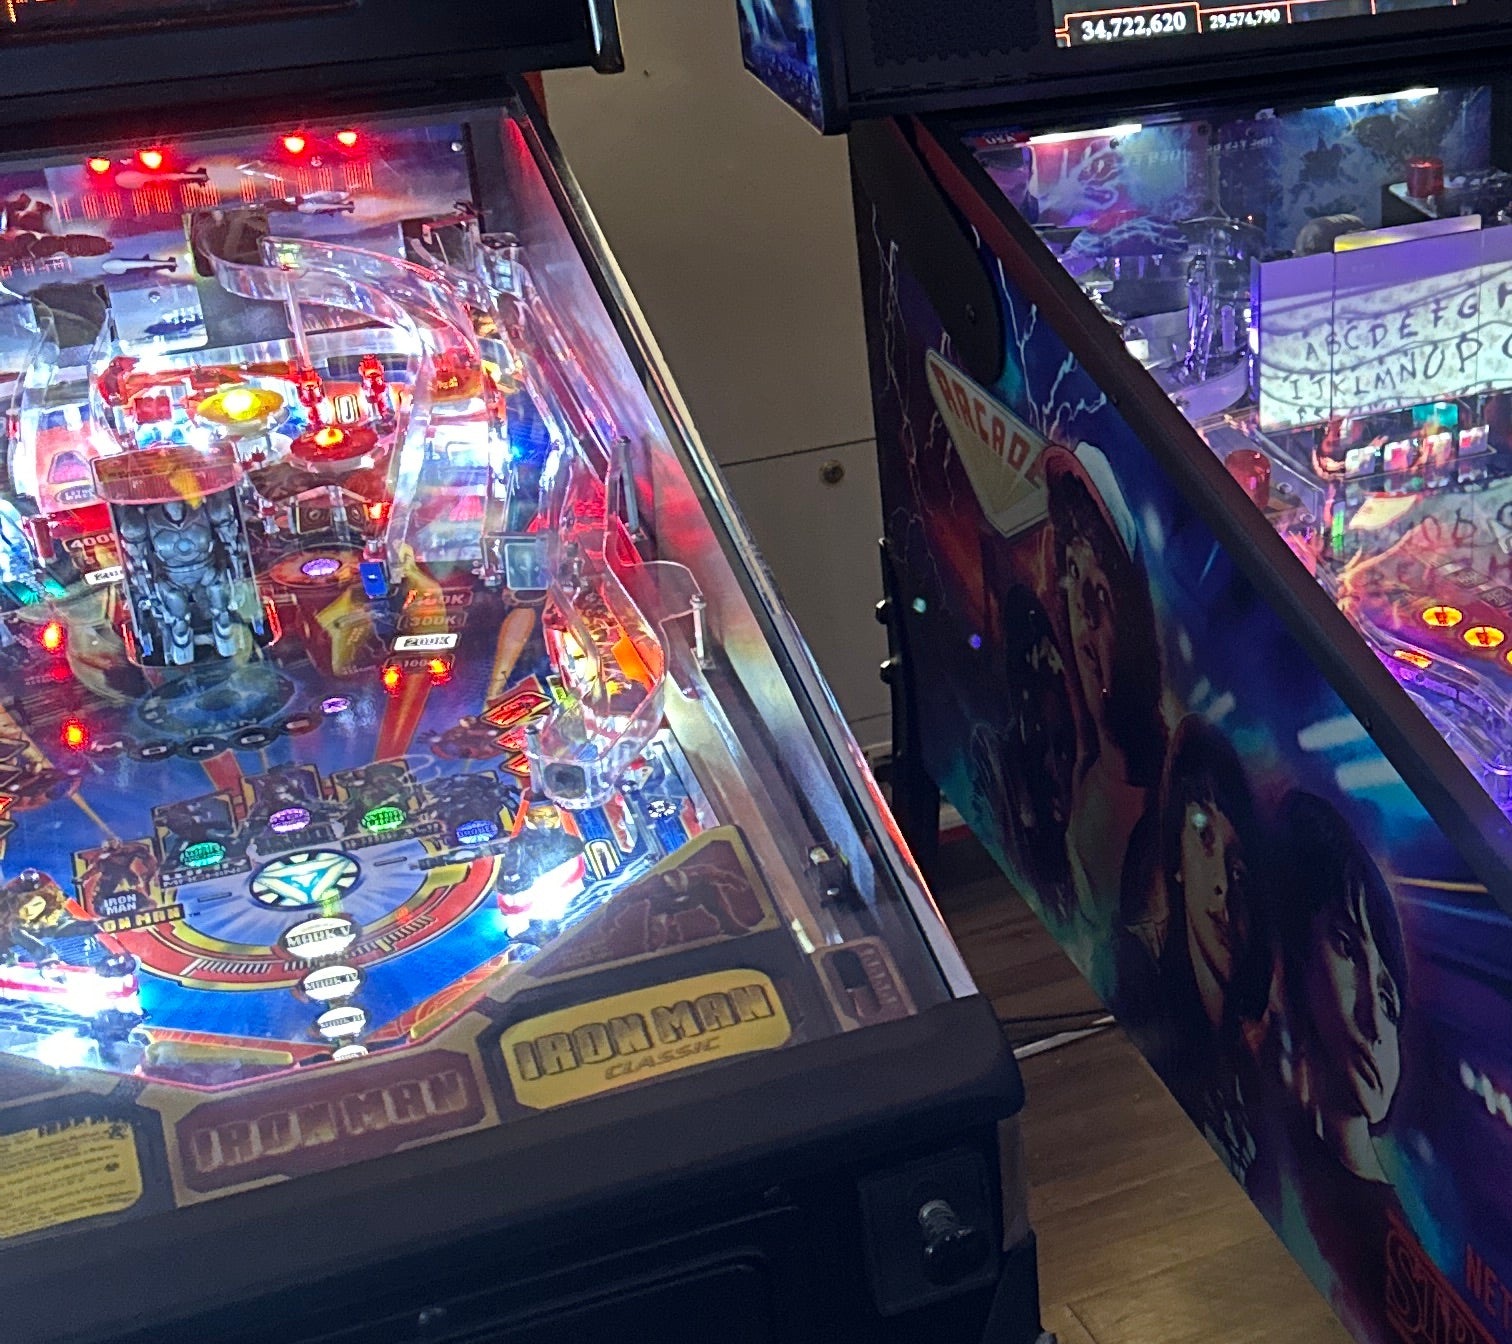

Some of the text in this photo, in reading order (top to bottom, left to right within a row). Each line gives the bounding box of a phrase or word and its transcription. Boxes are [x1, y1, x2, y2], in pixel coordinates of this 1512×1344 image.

[1081, 8, 1281, 42] 34,722,620 29,574,790
[104, 894, 136, 908] IRON
[107, 903, 136, 915] MAN
[136, 907, 180, 928] MAN
[287, 929, 335, 948] MARK
[512, 984, 775, 1081] IRON MAN
[604, 1036, 720, 1080] CLASSIC
[195, 1070, 467, 1173] IRON MAN
